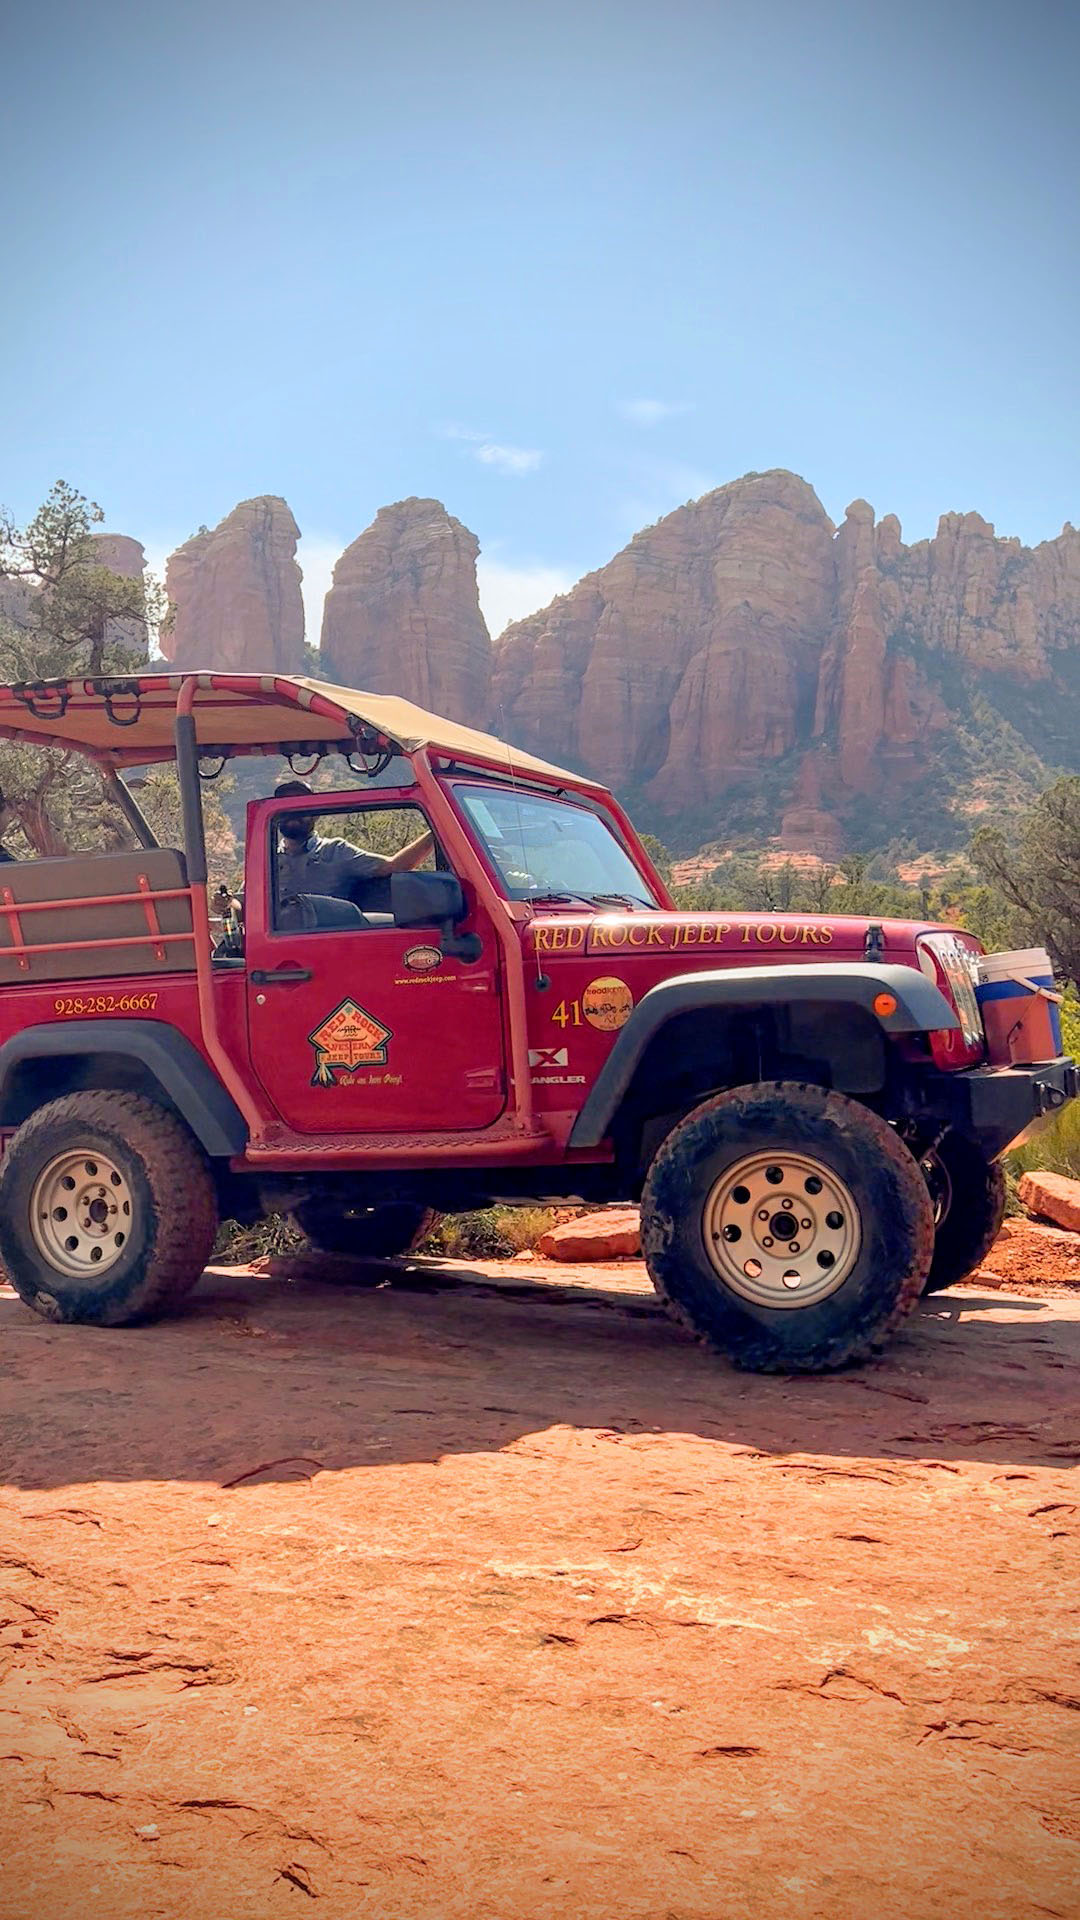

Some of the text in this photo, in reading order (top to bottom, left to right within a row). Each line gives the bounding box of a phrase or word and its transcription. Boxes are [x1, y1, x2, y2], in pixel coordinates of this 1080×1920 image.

[534, 922, 834, 951] RED ROCK JEEP TOURS
[54, 993, 159, 1016] 928-282-6667
[552, 1000, 583, 1028] 41
[319, 1010, 385, 1041] RED ROCK
[326, 1052, 382, 1062] JEEP TOURS
[511, 1076, 586, 1085] ANGLER
